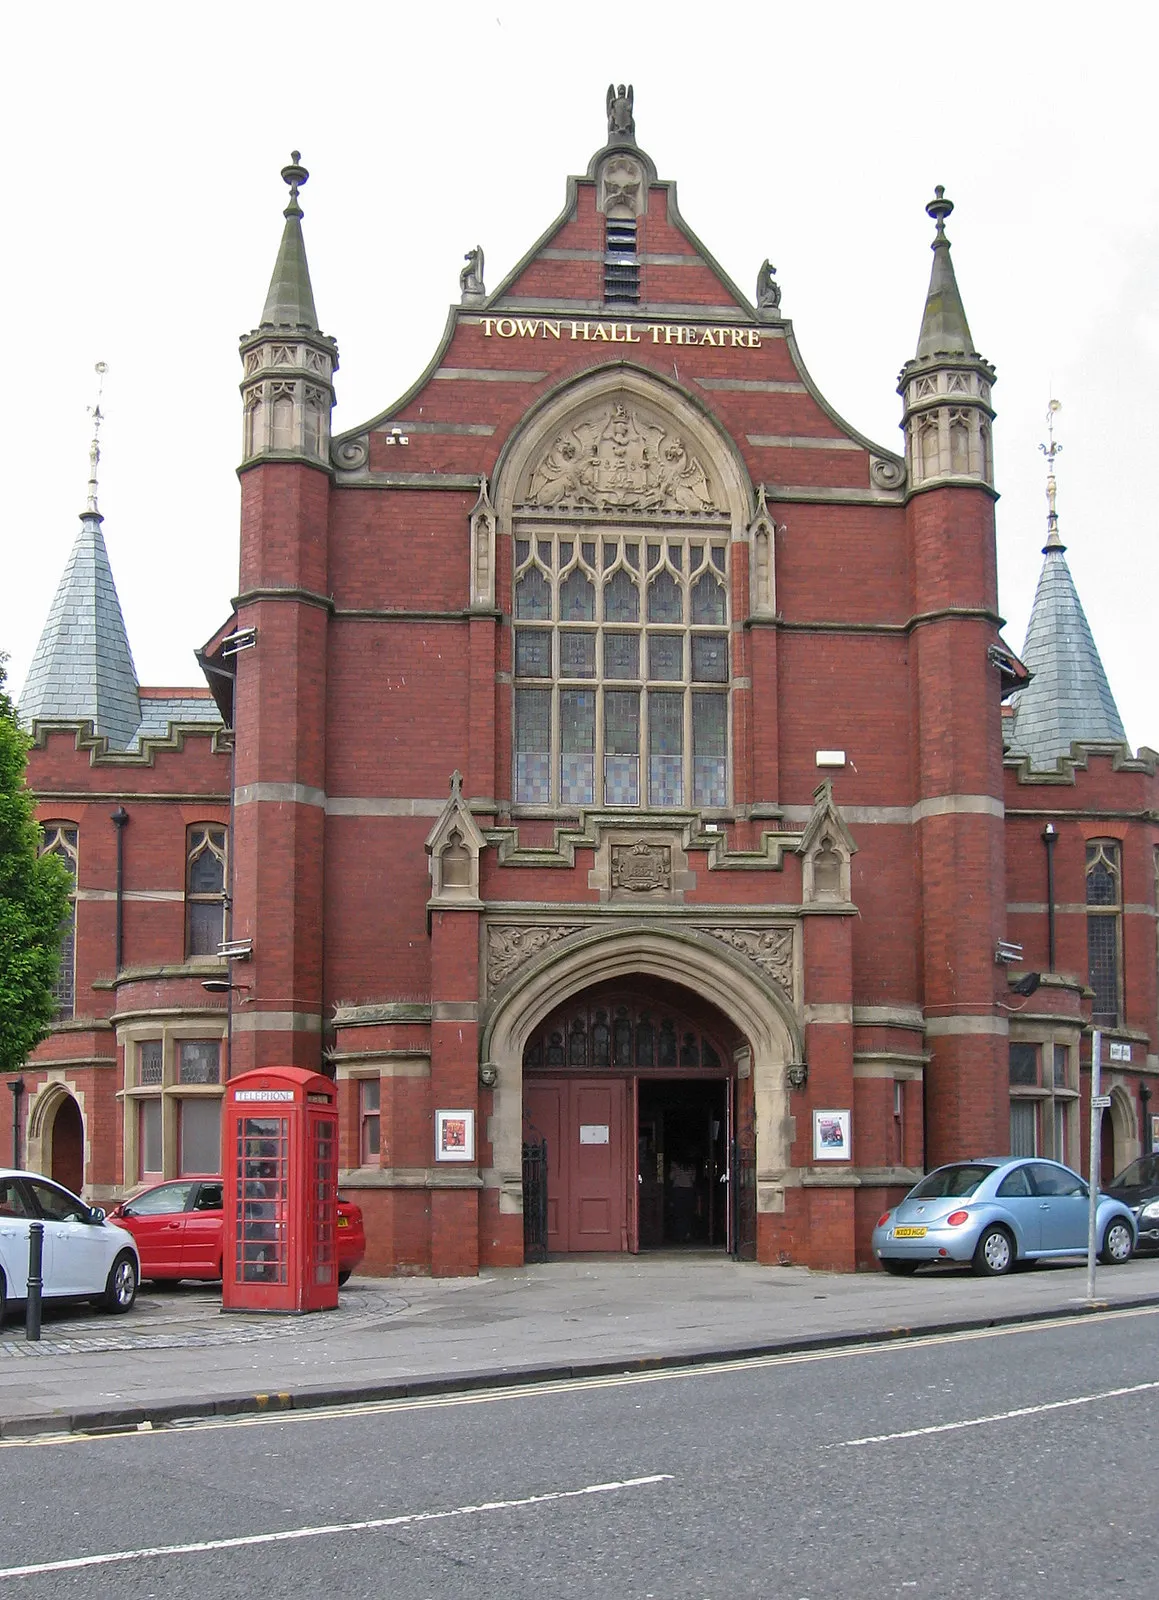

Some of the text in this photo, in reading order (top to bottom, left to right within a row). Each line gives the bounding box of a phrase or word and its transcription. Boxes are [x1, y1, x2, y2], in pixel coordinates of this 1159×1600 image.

[480, 317, 762, 348] TOWN HALL THEATRE
[238, 1091, 292, 1100] TELEPHONE
